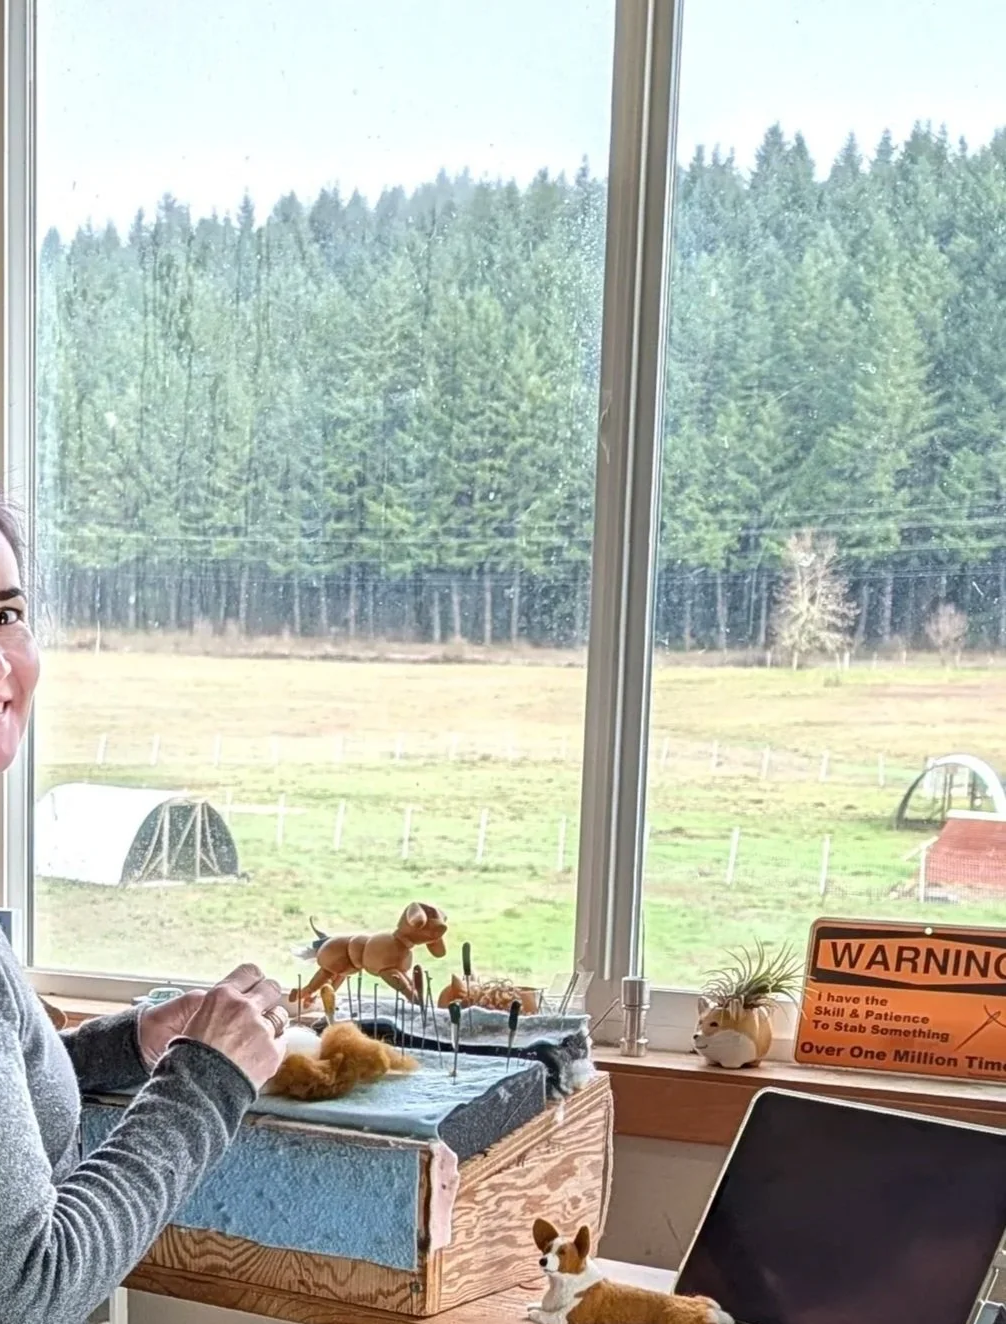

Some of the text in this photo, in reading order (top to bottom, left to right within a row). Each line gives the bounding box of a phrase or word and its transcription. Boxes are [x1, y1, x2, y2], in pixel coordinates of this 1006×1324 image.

[827, 992, 860, 1005] have
[865, 995, 889, 1006] the
[814, 1006, 930, 1025] Skill & Patience
[812, 1019, 951, 1043] To Stab Something
[800, 1041, 1006, 1072] Over One Million Tim
